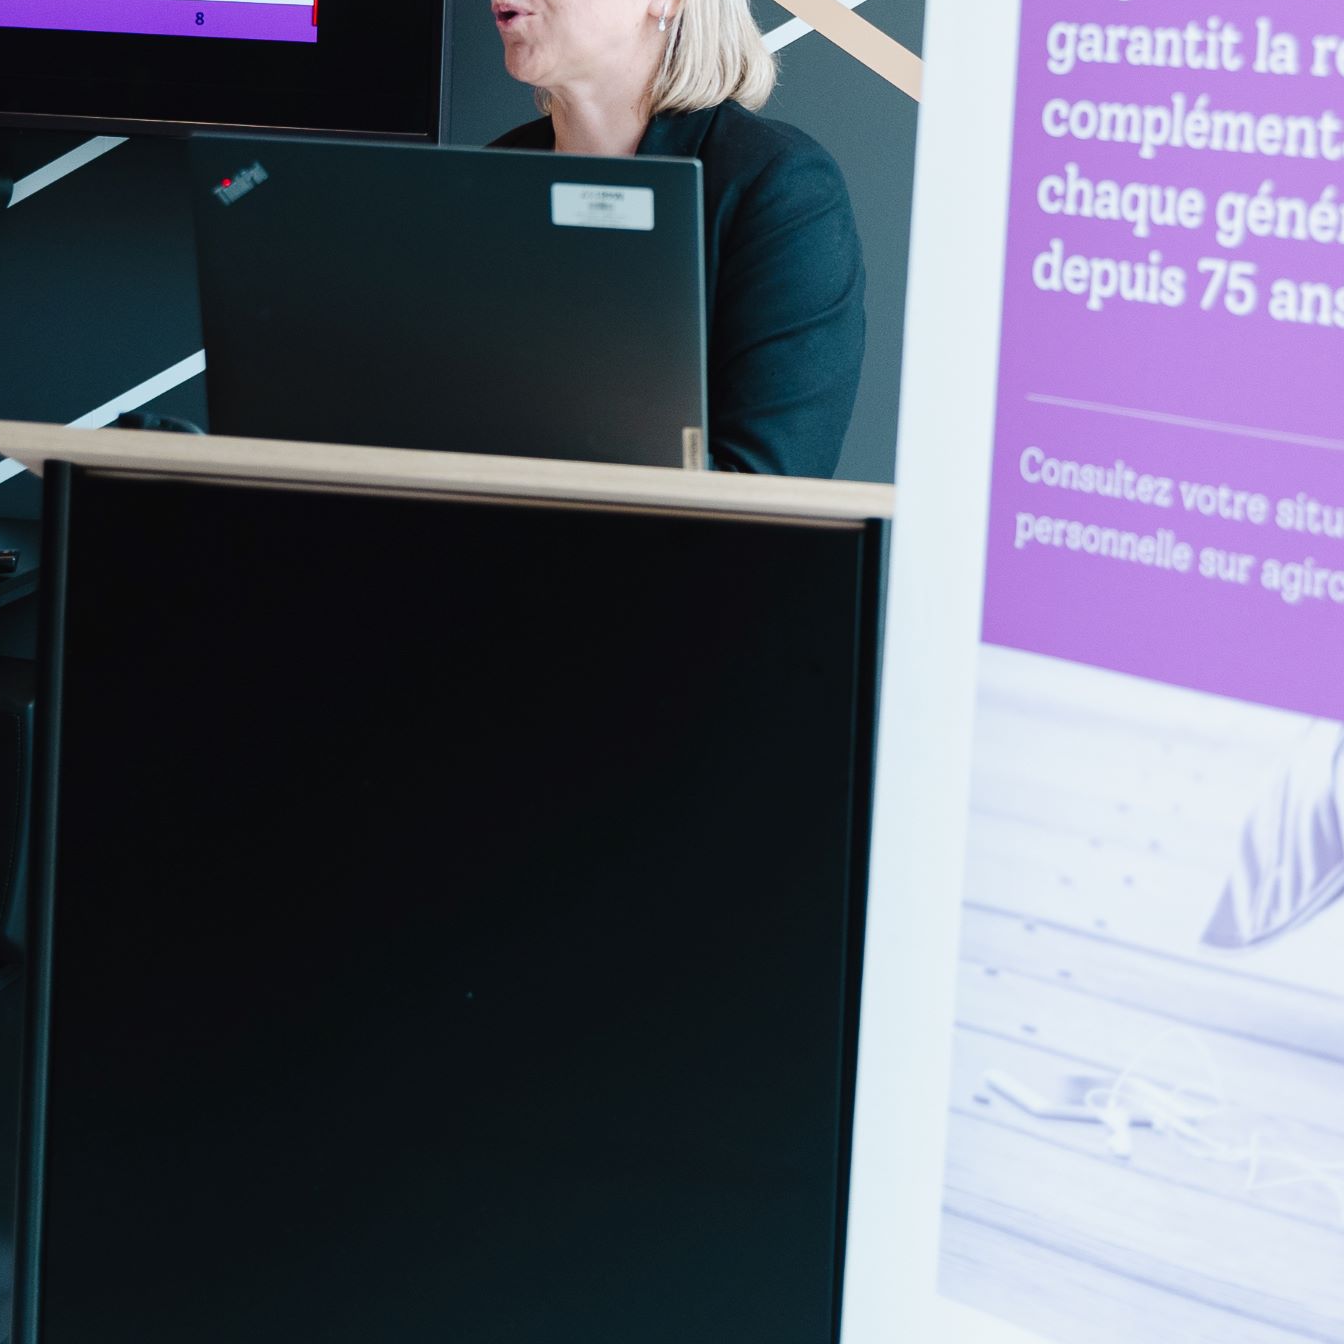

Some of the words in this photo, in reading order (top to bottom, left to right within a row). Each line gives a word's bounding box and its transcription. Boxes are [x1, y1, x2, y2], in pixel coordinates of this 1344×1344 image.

[195, 12, 204, 25] 8
[1046, 16, 1244, 75] garantit
[1253, 17, 1299, 75] la
[1037, 162, 1206, 238] chaque
[1032, 238, 1187, 311] depuis
[1197, 257, 1258, 316] 75
[1019, 446, 1174, 508] Consultez
[1179, 481, 1270, 525] votre
[1014, 512, 1194, 573] personnelle
[1198, 547, 1255, 584] sur
